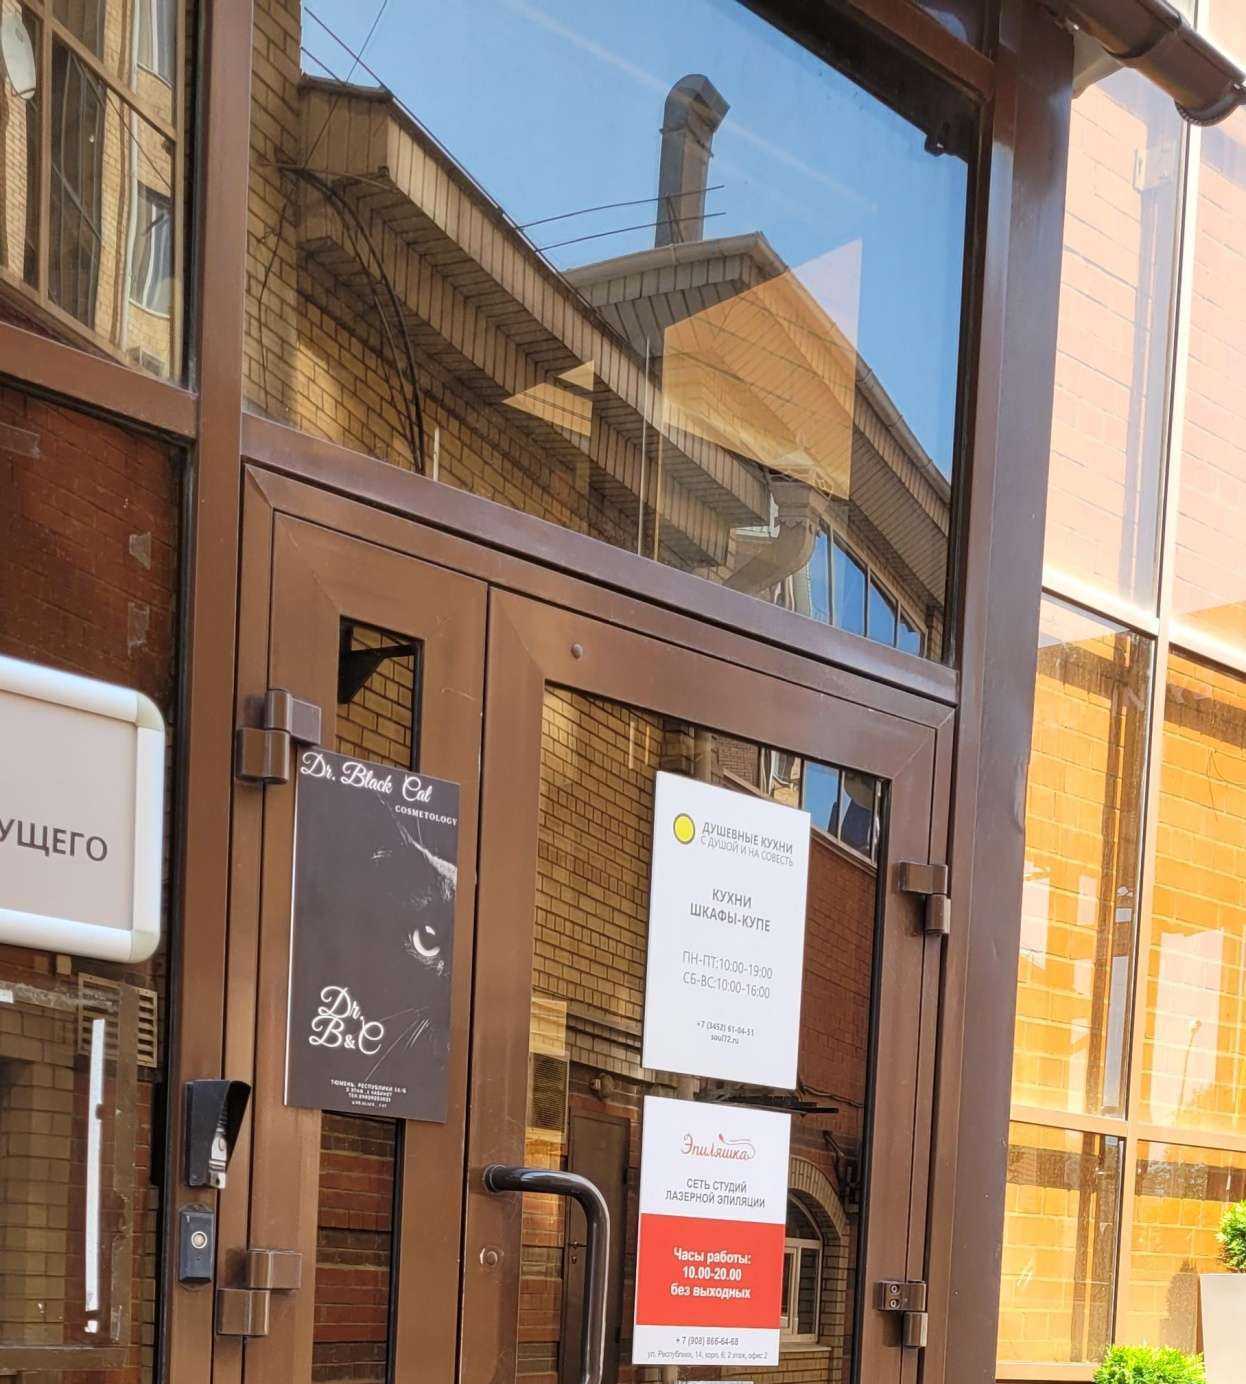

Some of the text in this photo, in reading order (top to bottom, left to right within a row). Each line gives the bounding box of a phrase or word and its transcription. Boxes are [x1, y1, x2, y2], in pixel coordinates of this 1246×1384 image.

[300, 751, 433, 803] Dr. Black Cat
[395, 804, 458, 827] COSMETOLOGY
[702, 821, 793, 854] ДУШЕВНЫЕ КУХНИ
[700, 835, 794, 867] С ДУШОЙ И НА СОВЕСТЬ
[712, 888, 752, 909] КУХНИ
[690, 902, 771, 932] ШКАФЫ-КУПЕ
[318, 985, 364, 1020] Dr.
[309, 1015, 384, 1055] B&C
[680, 1133, 753, 1160] Эпиляшка
[686, 1178, 748, 1193] СЕТЬ СТУДИЙ
[665, 1190, 766, 1208] ЛАЗЕРНОЙ ЭПИЛЯЦИИ
[673, 1246, 752, 1265] Часы работы:
[682, 1265, 742, 1281] 10.00-20.00
[670, 1282, 752, 1300] без выходных
